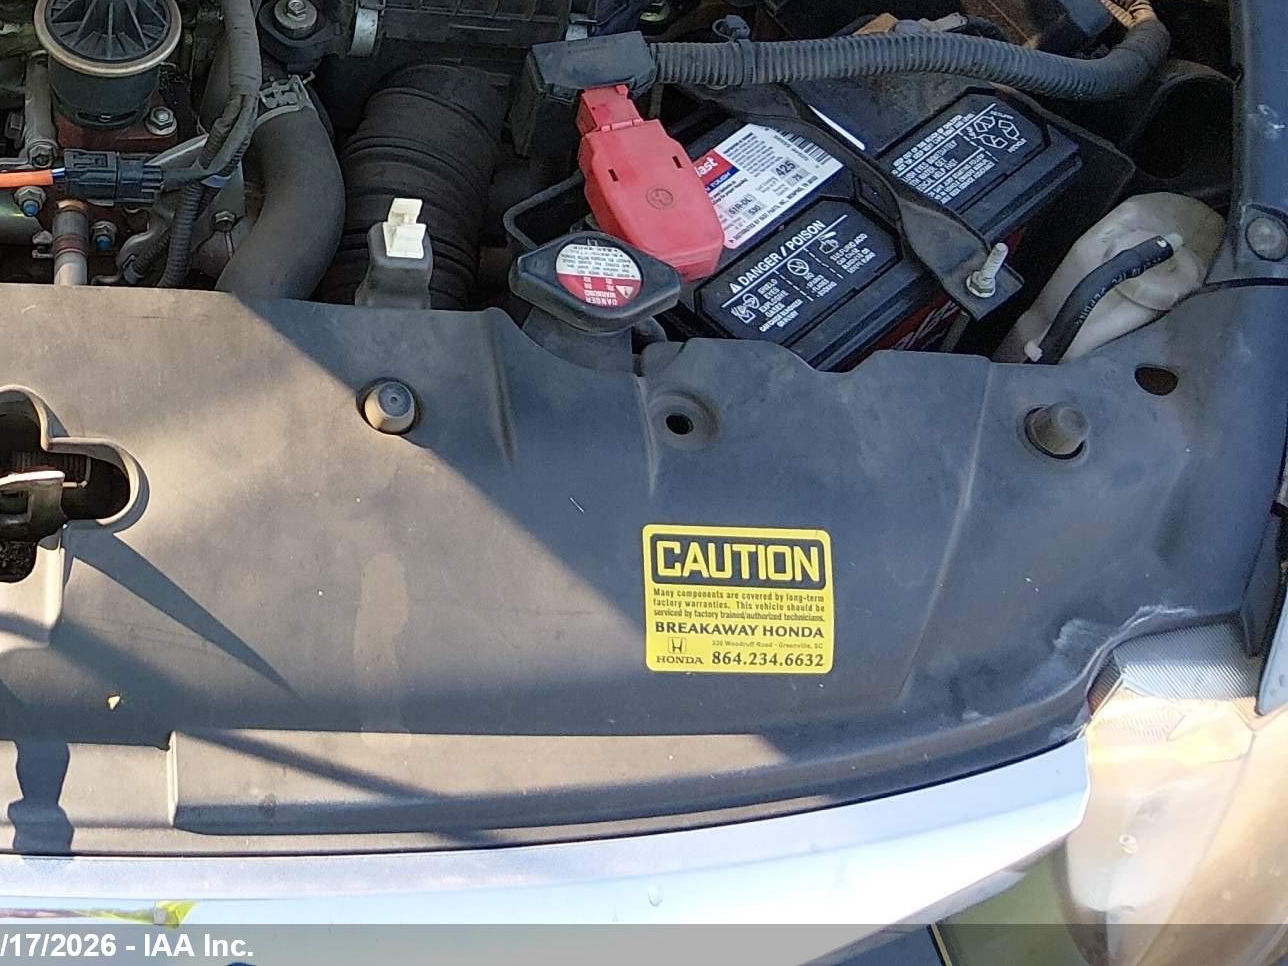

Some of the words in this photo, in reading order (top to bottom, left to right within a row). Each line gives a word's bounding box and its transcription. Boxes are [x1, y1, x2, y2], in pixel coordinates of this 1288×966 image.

[773, 159, 796, 177] 425
[736, 251, 783, 286] DANGER
[784, 219, 826, 250] POISON
[762, 285, 780, 299] EYES
[584, 296, 617, 305] DANGER
[655, 540, 820, 582] CAUTION
[654, 588, 674, 597] Many
[677, 590, 724, 599] components
[742, 592, 772, 600] covered
[775, 592, 783, 602] by
[787, 594, 824, 603] long-term
[653, 599, 681, 608] factory
[685, 601, 730, 609] warranties.
[736, 601, 752, 610] This
[787, 604, 812, 612] should
[816, 604, 824, 612] be
[654, 609, 682, 617] serviced
[684, 610, 692, 619] by
[695, 610, 718, 619] factory
[784, 614, 824, 622] technicians.
[656, 621, 757, 636] BREAKAWAY
[763, 626, 824, 638] HONDA
[656, 655, 704, 664] HONDA
[712, 651, 824, 666] 864.234.6632
